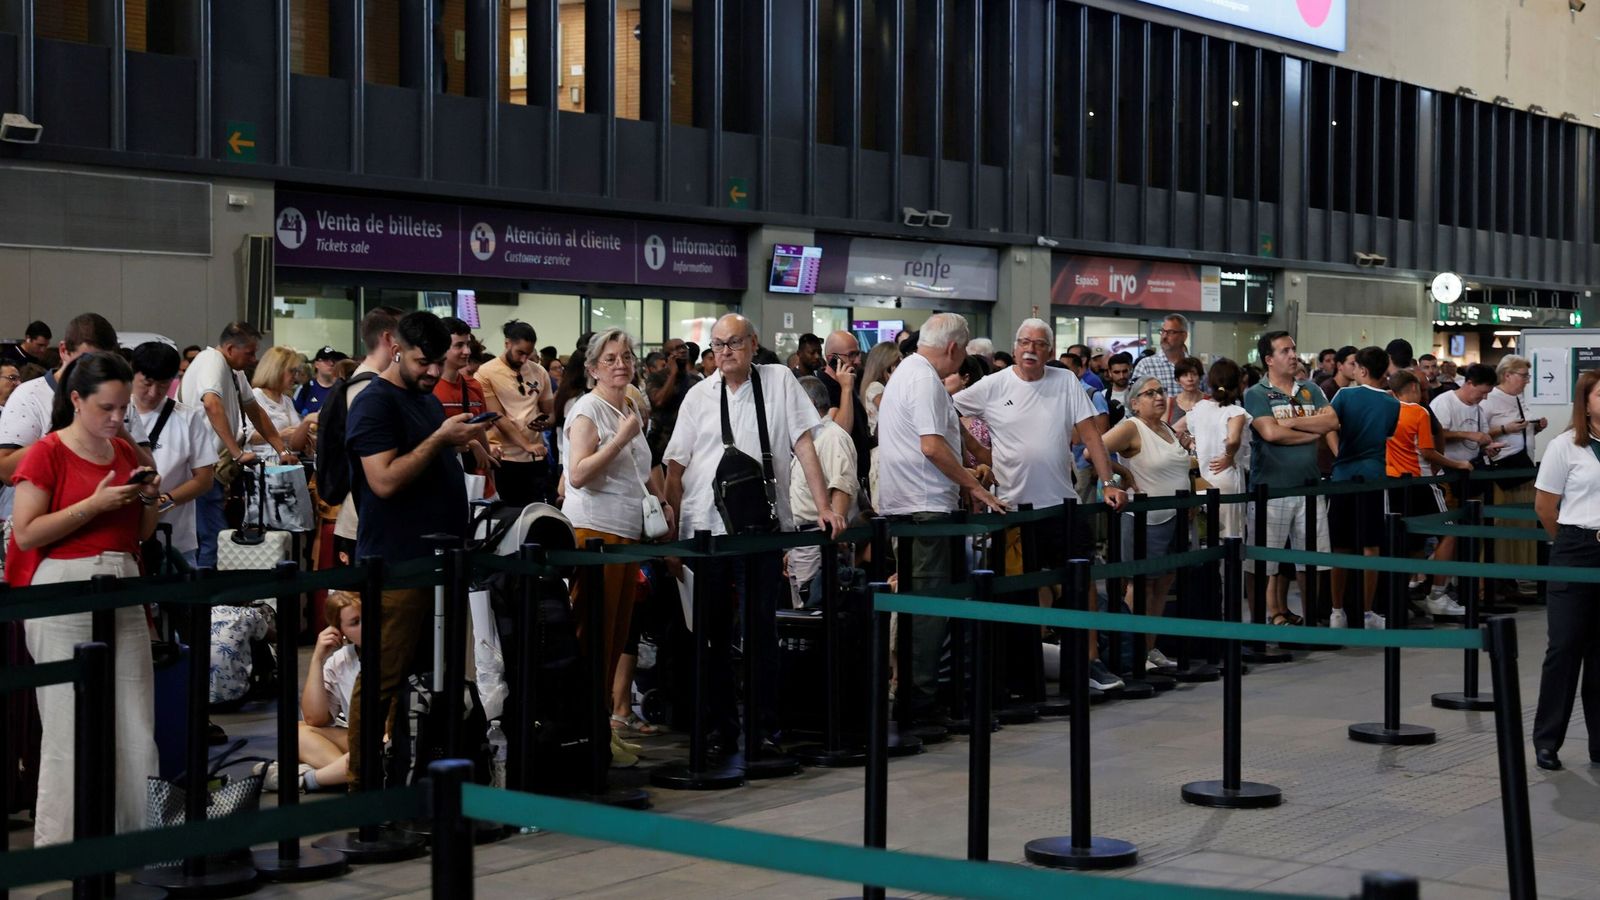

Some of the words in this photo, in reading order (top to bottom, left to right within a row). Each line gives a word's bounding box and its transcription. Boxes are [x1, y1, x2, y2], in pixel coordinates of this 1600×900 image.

[317, 210, 361, 233] Venta
[365, 213, 384, 234] de
[389, 214, 443, 238] billetes
[316, 238, 348, 253] Tickets
[350, 240, 370, 254] sale
[505, 224, 561, 246] Atención
[565, 228, 577, 248] al
[580, 230, 621, 250] cliente
[673, 236, 737, 257] Información
[504, 250, 542, 265] Customer
[543, 253, 571, 266] service
[673, 260, 713, 275] Information
[904, 253, 950, 287] renfe
[1075, 274, 1099, 288] Espacio
[1109, 265, 1137, 301] iryo
